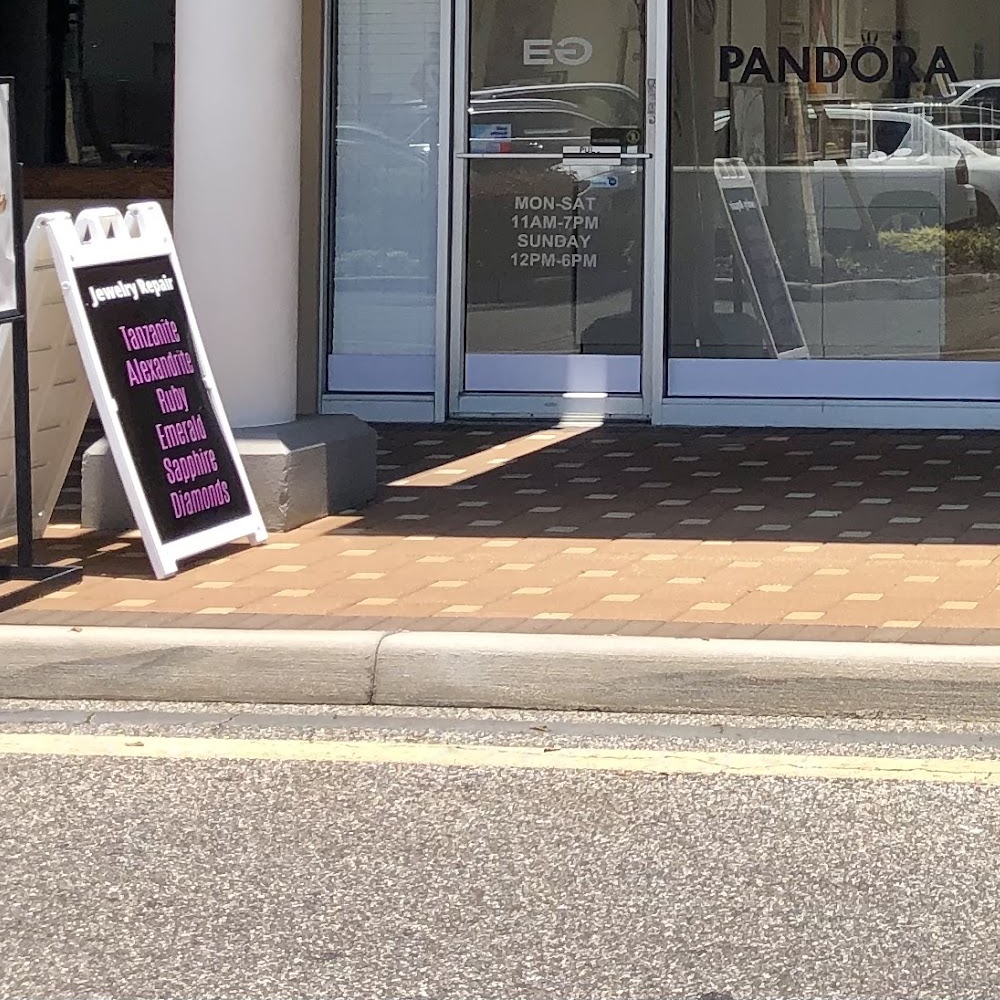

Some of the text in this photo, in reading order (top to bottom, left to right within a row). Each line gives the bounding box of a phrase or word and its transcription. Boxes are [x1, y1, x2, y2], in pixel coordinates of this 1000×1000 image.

[719, 40, 959, 84] PANDORA
[514, 196, 596, 211] MON-SAT
[511, 215, 599, 230] 11AM-7PM
[517, 234, 591, 249] SUNDAY
[510, 253, 597, 268] 12PM-6PM
[88, 273, 175, 309] Jewelry Repair
[118, 318, 180, 352] Tanzanite
[125, 349, 195, 387] Alexandrite
[155, 385, 190, 414] Ruby
[155, 413, 208, 451] Emerald
[163, 448, 219, 485] Sapphire
[169, 478, 231, 520] Diamonds
